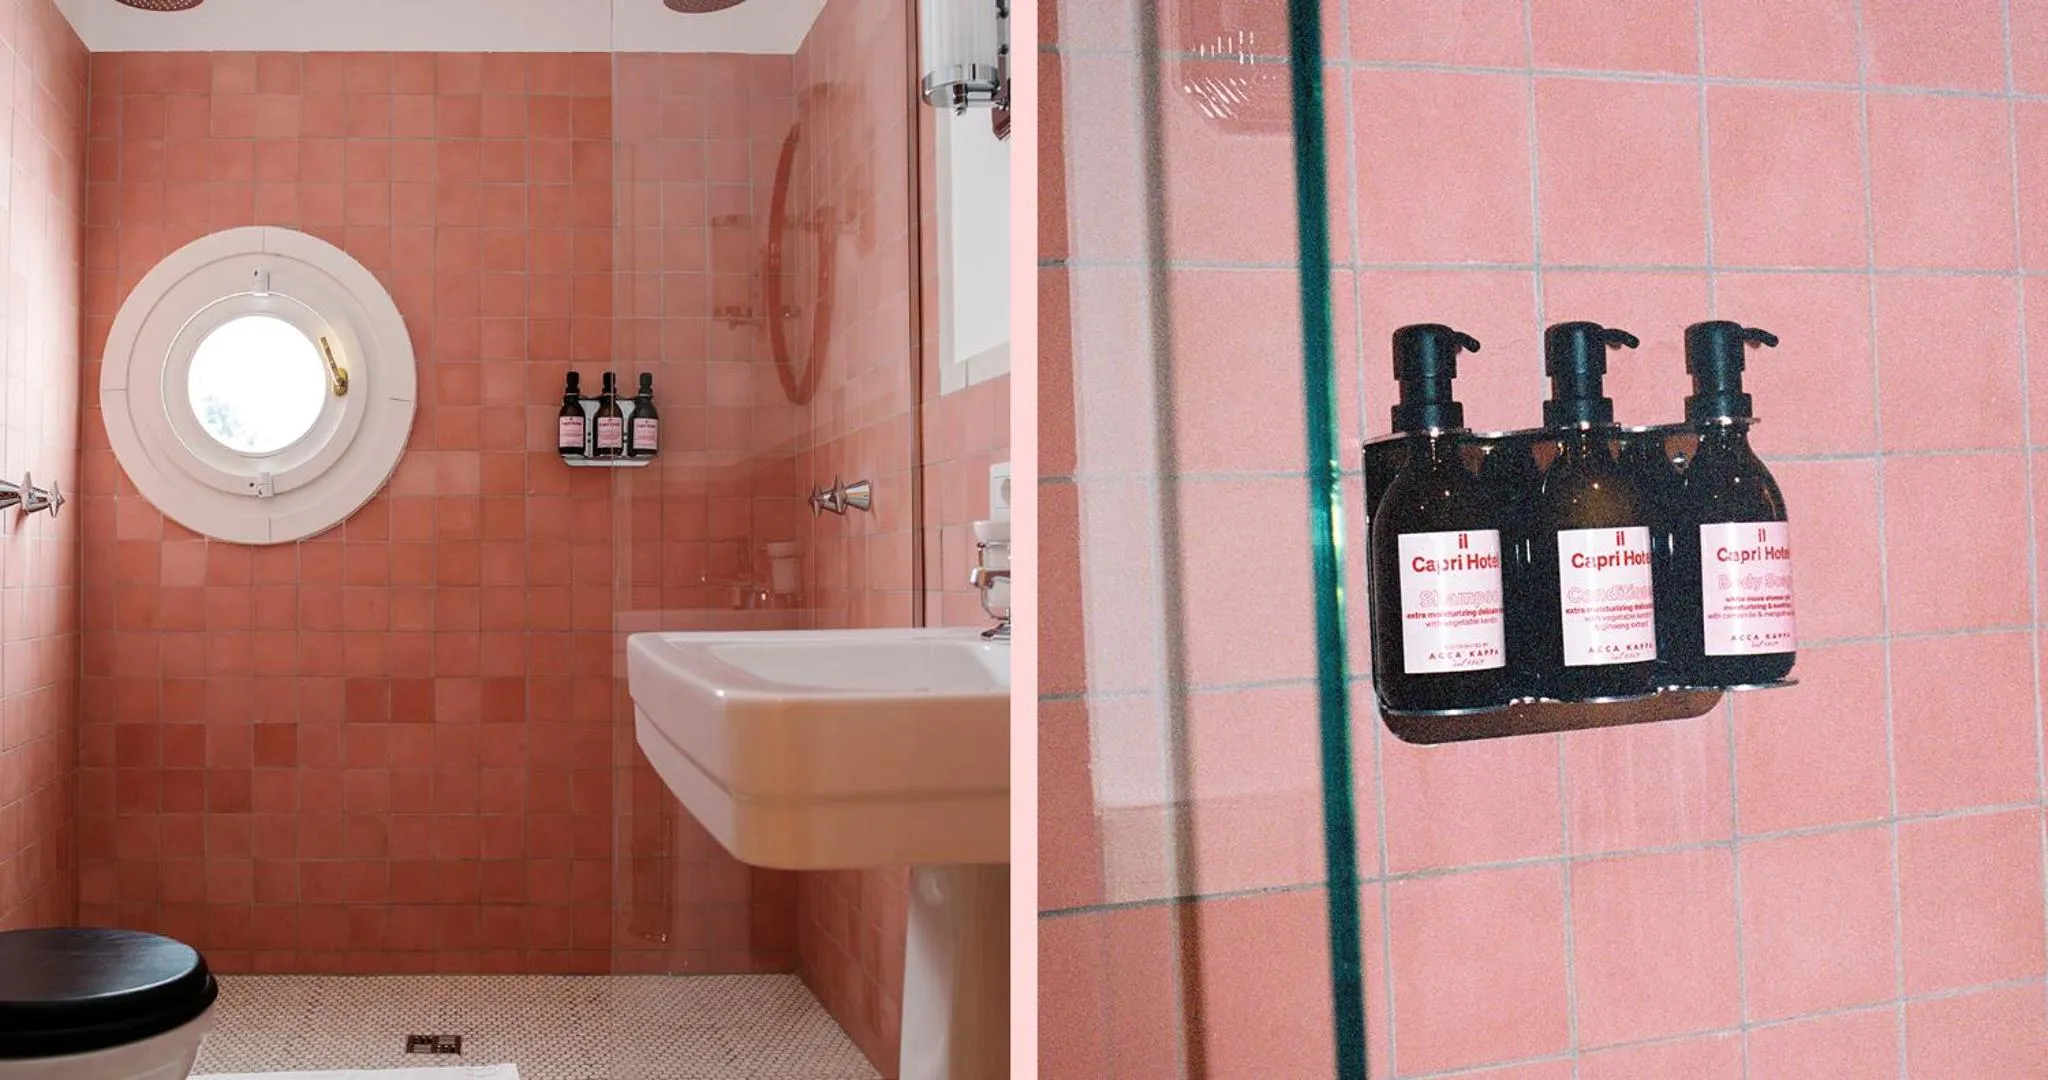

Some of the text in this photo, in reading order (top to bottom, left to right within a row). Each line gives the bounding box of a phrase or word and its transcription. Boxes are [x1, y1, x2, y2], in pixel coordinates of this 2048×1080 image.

[1458, 533, 1469, 550] il
[1615, 530, 1626, 547] il
[1757, 527, 1767, 543] il
[1412, 554, 1464, 575] Capri
[1571, 551, 1621, 572] Capri
[1717, 573, 1762, 592] Bdy
[1428, 652, 1462, 661] ACCA
[1587, 644, 1621, 653] ACCA
